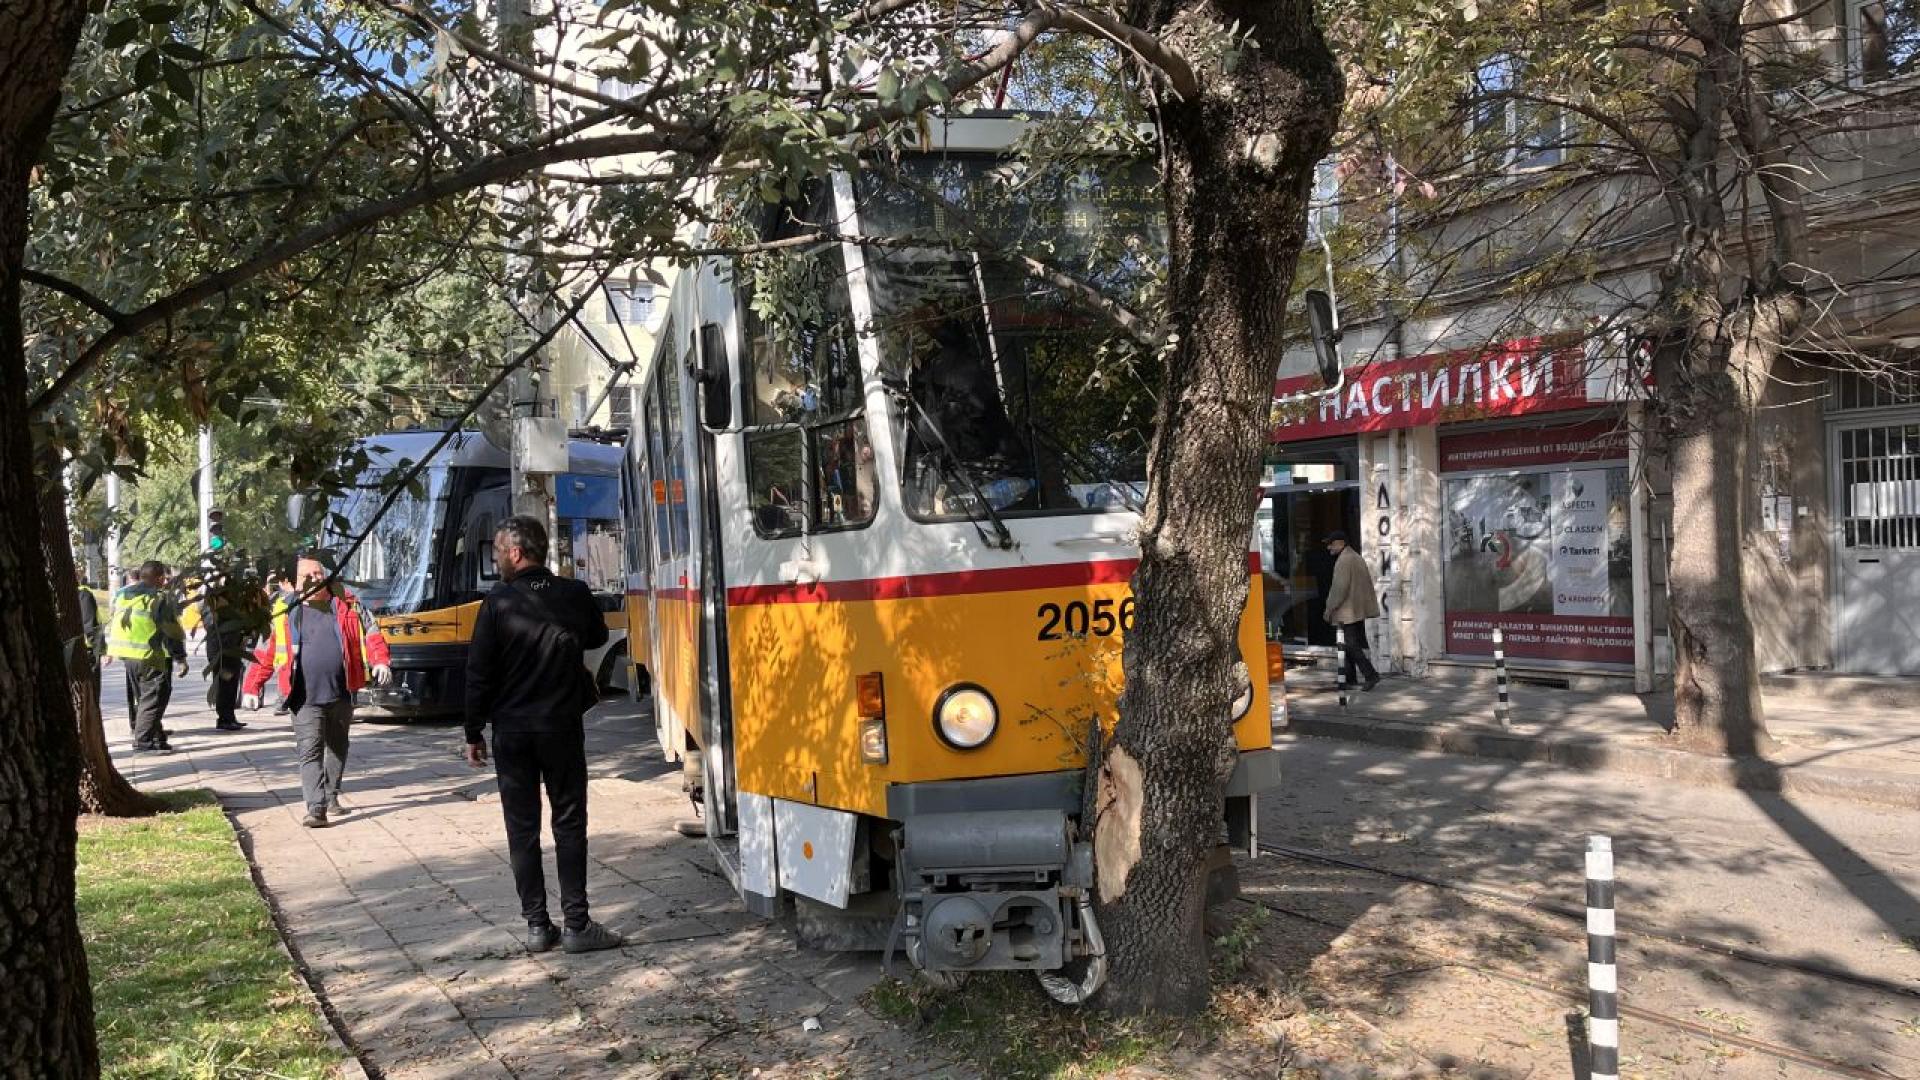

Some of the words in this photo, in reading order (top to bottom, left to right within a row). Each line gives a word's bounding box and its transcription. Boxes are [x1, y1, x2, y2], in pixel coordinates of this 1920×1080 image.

[1319, 350, 1554, 423] НАСТИЛКИ
[1564, 526, 1603, 534] CLASSEN
[1569, 547, 1600, 556] Tarkett
[1037, 596, 1135, 642] 2056
[1588, 626, 1634, 634] НАСТИЛКИ
